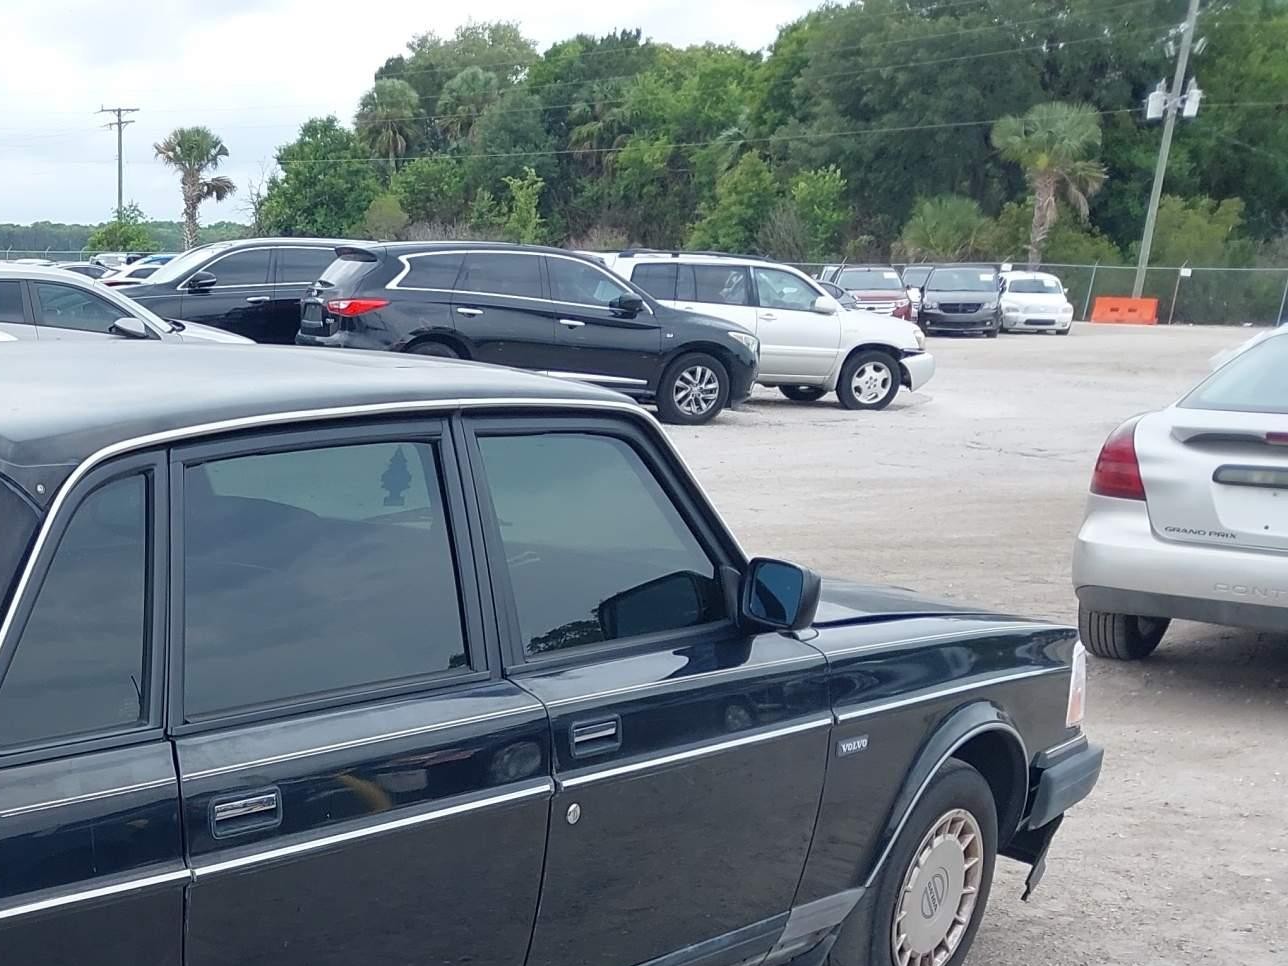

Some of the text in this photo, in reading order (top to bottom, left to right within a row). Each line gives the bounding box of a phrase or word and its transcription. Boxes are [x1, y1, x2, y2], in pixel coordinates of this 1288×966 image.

[1164, 526, 1237, 540] GRAND PRIX
[840, 738, 869, 753] VOLVO
